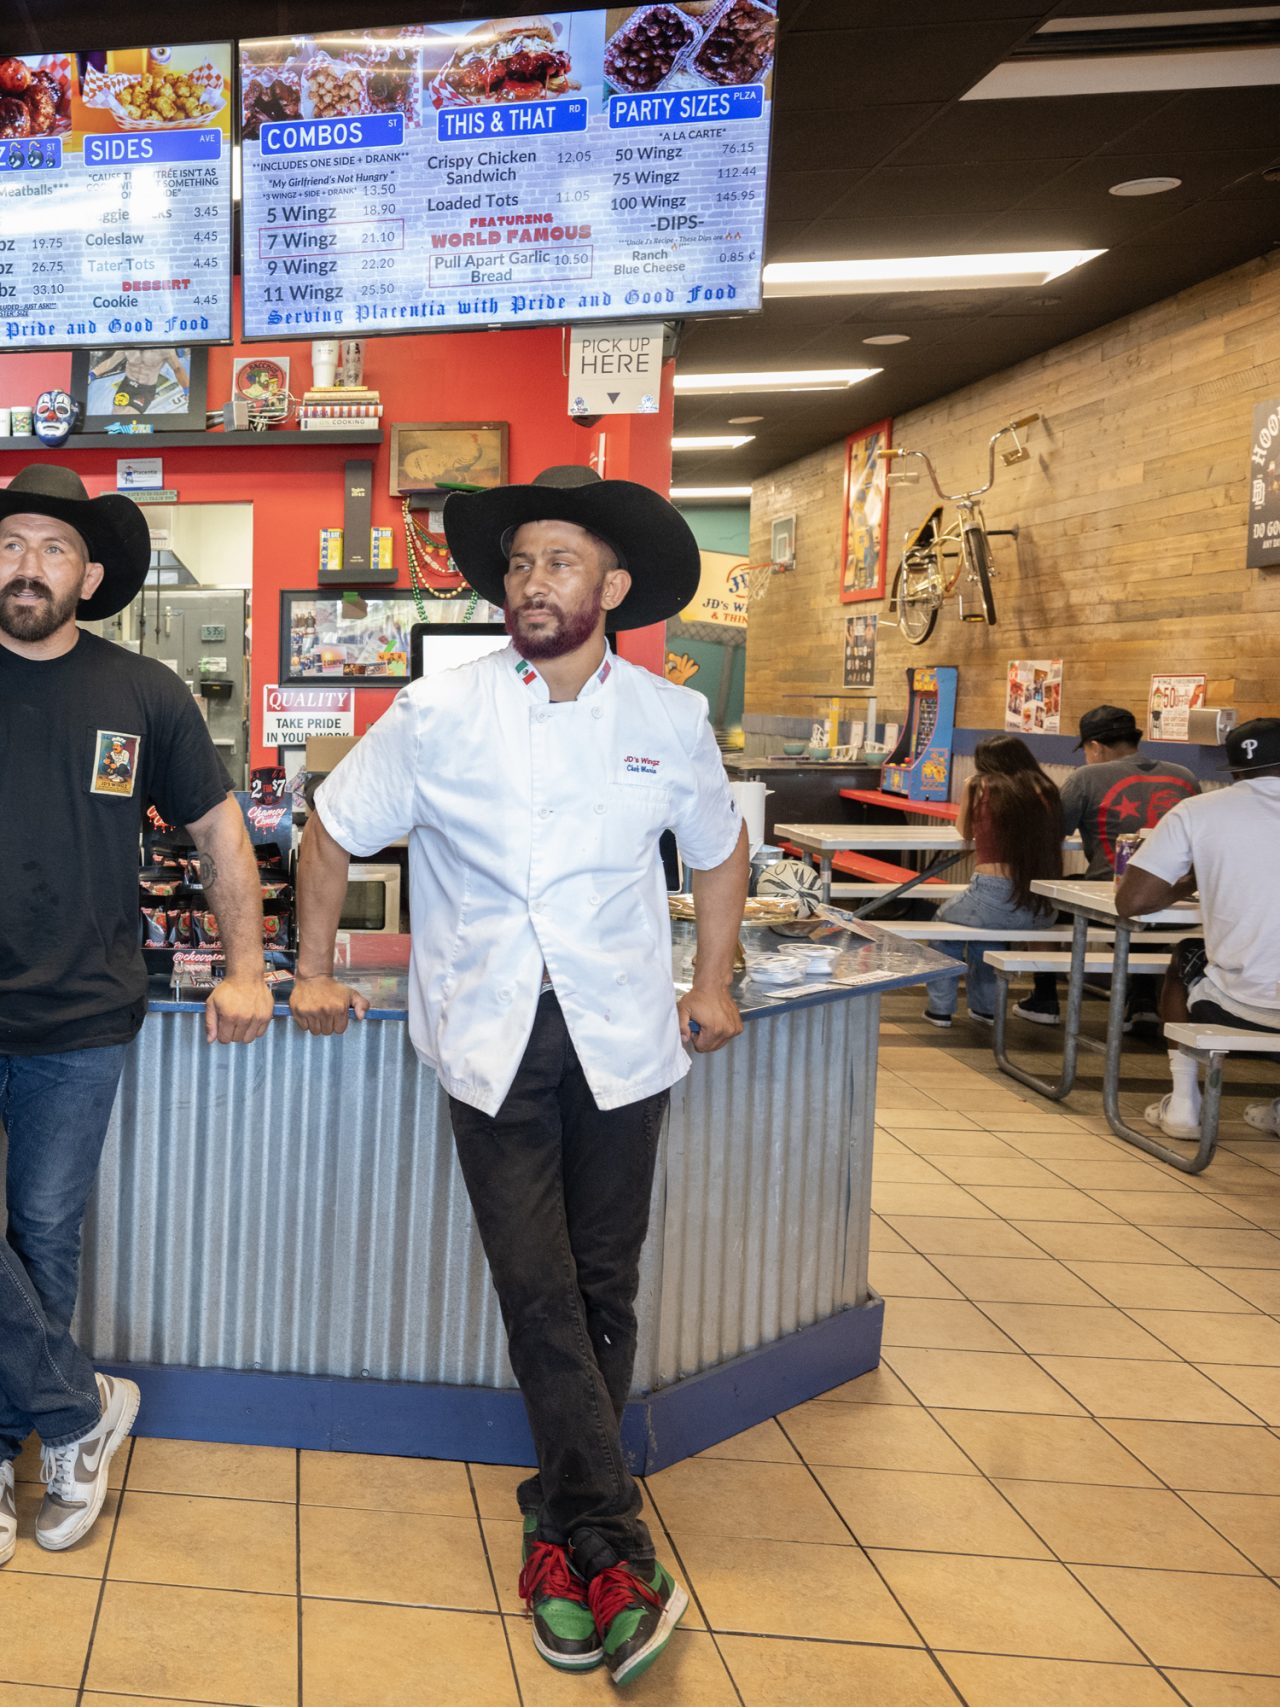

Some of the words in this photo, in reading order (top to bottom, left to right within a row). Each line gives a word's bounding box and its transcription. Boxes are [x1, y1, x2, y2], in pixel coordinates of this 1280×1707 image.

[616, 97, 675, 123] PARTY
[679, 93, 730, 118] SIZES
[445, 112, 485, 136] THIS
[490, 111, 504, 133] &
[509, 107, 556, 131] THAT
[267, 122, 363, 150] COMBOS
[91, 138, 153, 161] SIDES
[615, 148, 633, 162] 50
[637, 147, 682, 161] Wingz
[722, 142, 754, 154] 76.15
[310, 157, 331, 168] ONE
[333, 156, 355, 166] SIDE
[427, 155, 473, 170] Crispy
[477, 150, 537, 166] Chicken
[557, 151, 591, 163] 12.05
[446, 167, 517, 185] Sandwich
[613, 172, 630, 186] 75
[635, 171, 680, 185] Wingz
[718, 166, 756, 179] 112.44
[363, 184, 396, 196] 13.50
[427, 196, 481, 212] Loaded
[485, 194, 519, 208] Tots
[611, 197, 638, 211] 100
[641, 196, 686, 209] Wingz
[716, 190, 755, 202] 145.95
[194, 206, 218, 218] 3.45
[267, 207, 276, 223] 5
[282, 205, 337, 223] Wingz
[470, 213, 554, 228] FEATURING
[32, 238, 63, 250] 19.75
[85, 234, 144, 246] Coleslaw
[193, 231, 218, 242] 4.45
[267, 234, 278, 250] 7
[283, 232, 337, 250] Wingz
[431, 230, 501, 249] WORLD
[507, 224, 592, 244] FAMOUS
[434, 255, 461, 269] Pull
[464, 253, 505, 269] Apart
[509, 250, 550, 264] Garlic
[554, 253, 589, 266] 10.50
[632, 249, 668, 261] Ranch
[88, 260, 123, 272] Tater
[125, 258, 155, 271] Tots
[193, 257, 218, 269] 4.45
[267, 260, 278, 276] 9
[283, 258, 337, 276] Wingz
[614, 264, 640, 276] Blue
[643, 262, 686, 274] Cheese
[122, 278, 191, 292] DESSERT
[471, 269, 513, 283] Bread
[33, 284, 64, 295] 33.10
[264, 286, 284, 302] 11
[289, 284, 343, 301] Wingz
[93, 295, 139, 308] Cookie
[193, 294, 218, 305] 4.45
[267, 306, 343, 326] Serving
[356, 300, 446, 323] Placentia
[458, 297, 498, 315] with
[510, 295, 566, 315] Pride
[624, 288, 674, 305] Good
[686, 283, 737, 304] Food
[6, 320, 55, 339] Pride
[66, 319, 96, 335] and
[108, 317, 153, 334] Good
[164, 316, 209, 333] Food
[582, 338, 623, 354] PICK
[629, 337, 650, 352] UP
[581, 353, 650, 374] HERE
[702, 598, 729, 610] JD's
[269, 691, 349, 710] QUALITY
[276, 718, 303, 729] TAKE
[307, 718, 342, 729] PRIDE
[267, 732, 278, 742] IN
[1241, 739, 1258, 759] P
[251, 779, 263, 798] 2
[272, 779, 286, 797] $7
